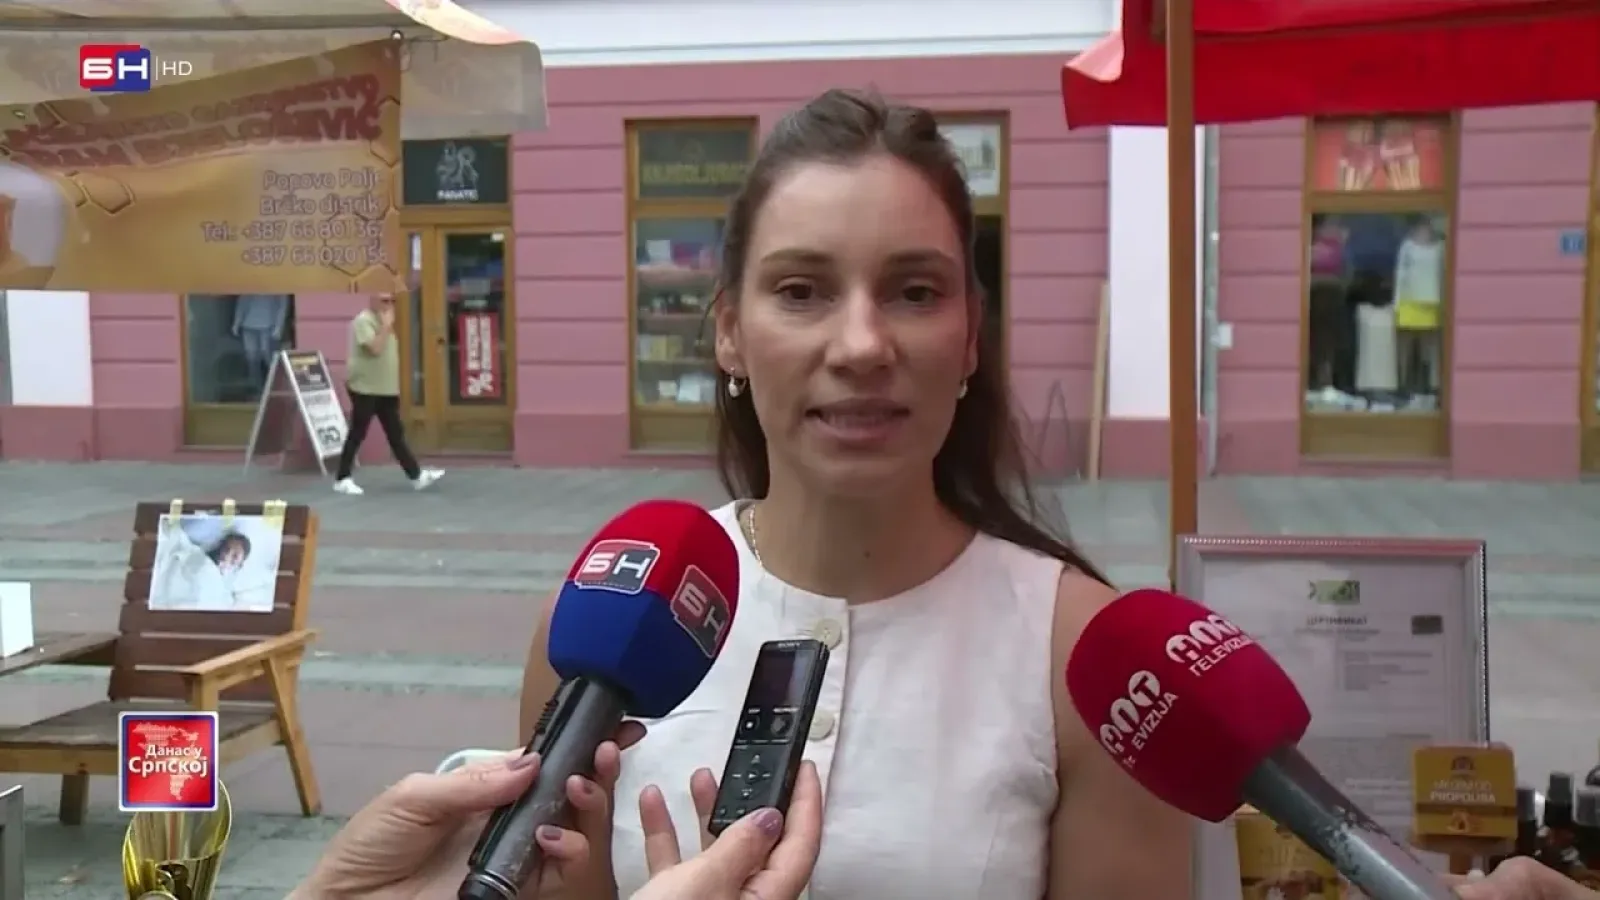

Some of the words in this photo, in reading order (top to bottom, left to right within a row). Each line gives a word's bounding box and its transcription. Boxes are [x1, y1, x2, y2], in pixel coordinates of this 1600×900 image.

[262, 168, 336, 191] Popovo
[260, 194, 316, 215] Brčko
[242, 219, 288, 242] +387
[290, 219, 315, 241] 66
[318, 219, 352, 241] 801
[356, 219, 385, 240] 36
[242, 244, 288, 266] +387
[290, 244, 315, 265] 66
[319, 244, 356, 266] 020
